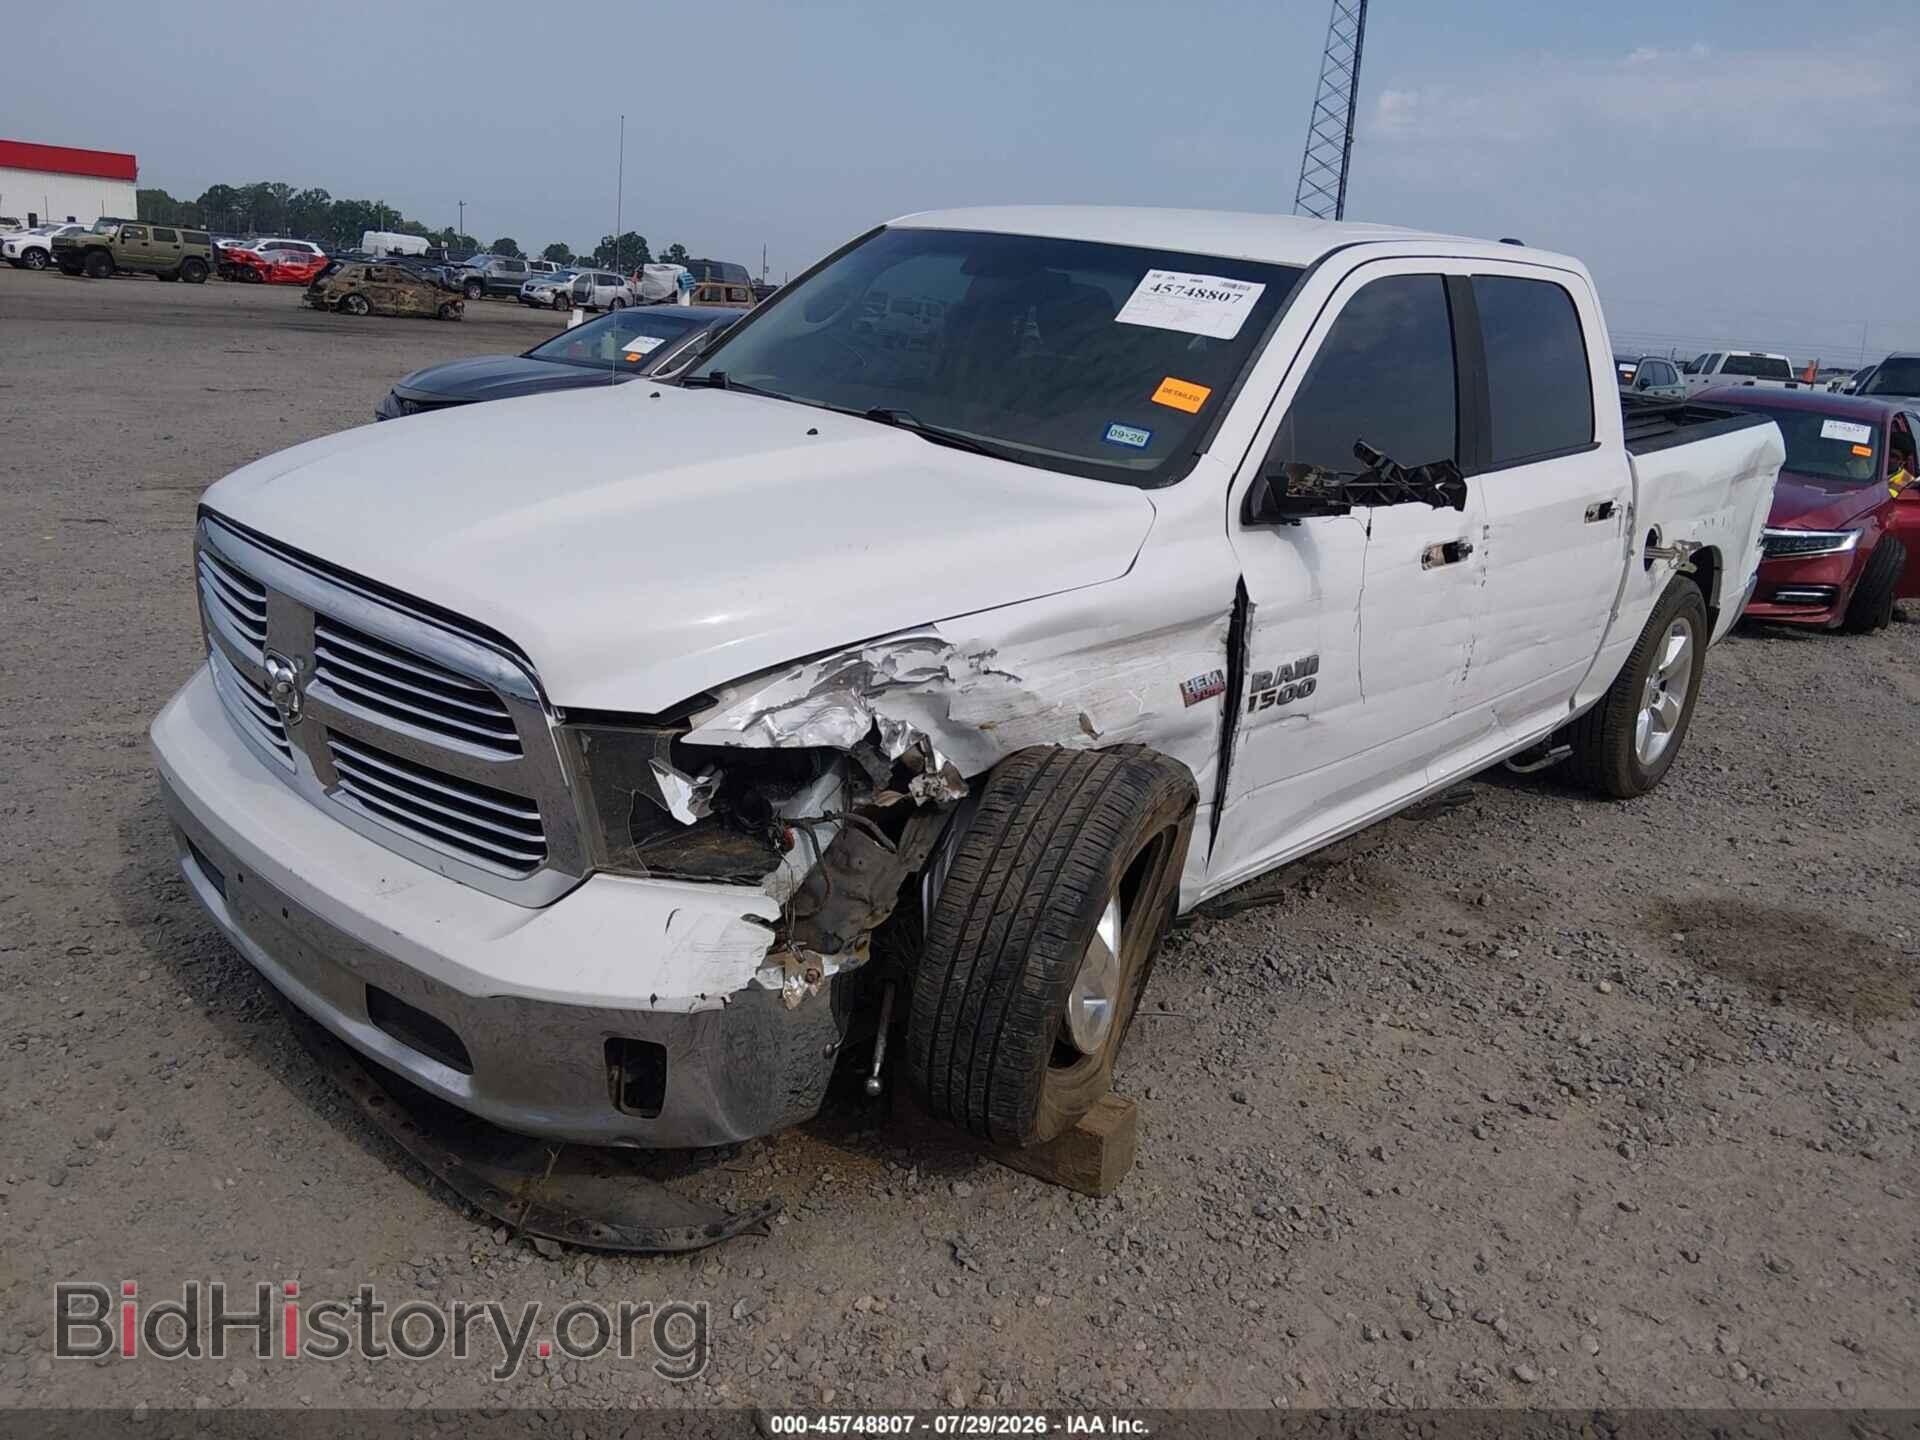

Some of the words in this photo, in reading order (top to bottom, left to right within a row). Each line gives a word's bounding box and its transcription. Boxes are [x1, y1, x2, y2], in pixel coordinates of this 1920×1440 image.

[1150, 282, 1243, 304] 45748807
[1162, 387, 1201, 401] DETAILED
[1251, 654, 1320, 693] RAM
[1247, 677, 1317, 713] 1500
